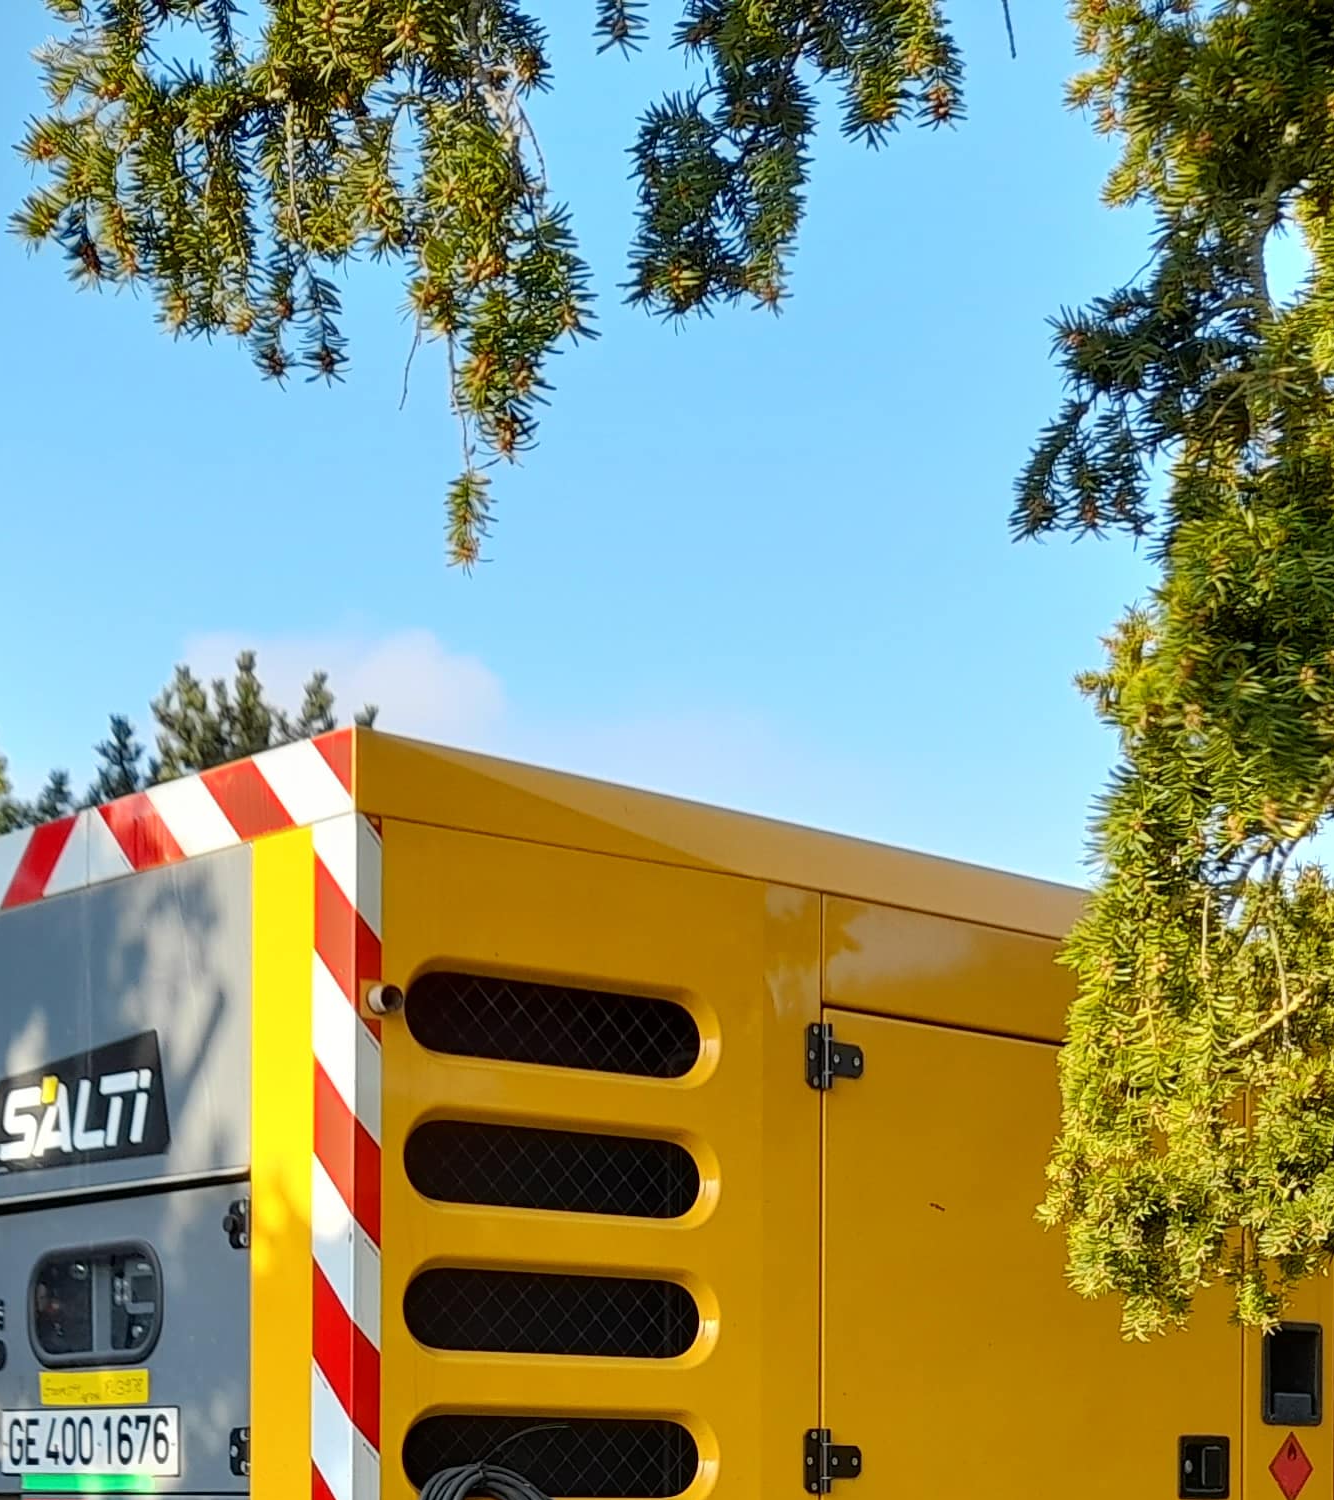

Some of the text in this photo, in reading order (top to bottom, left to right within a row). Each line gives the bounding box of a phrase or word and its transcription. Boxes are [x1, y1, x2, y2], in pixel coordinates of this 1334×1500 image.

[9, 1414, 170, 1466] GE 400 1676
